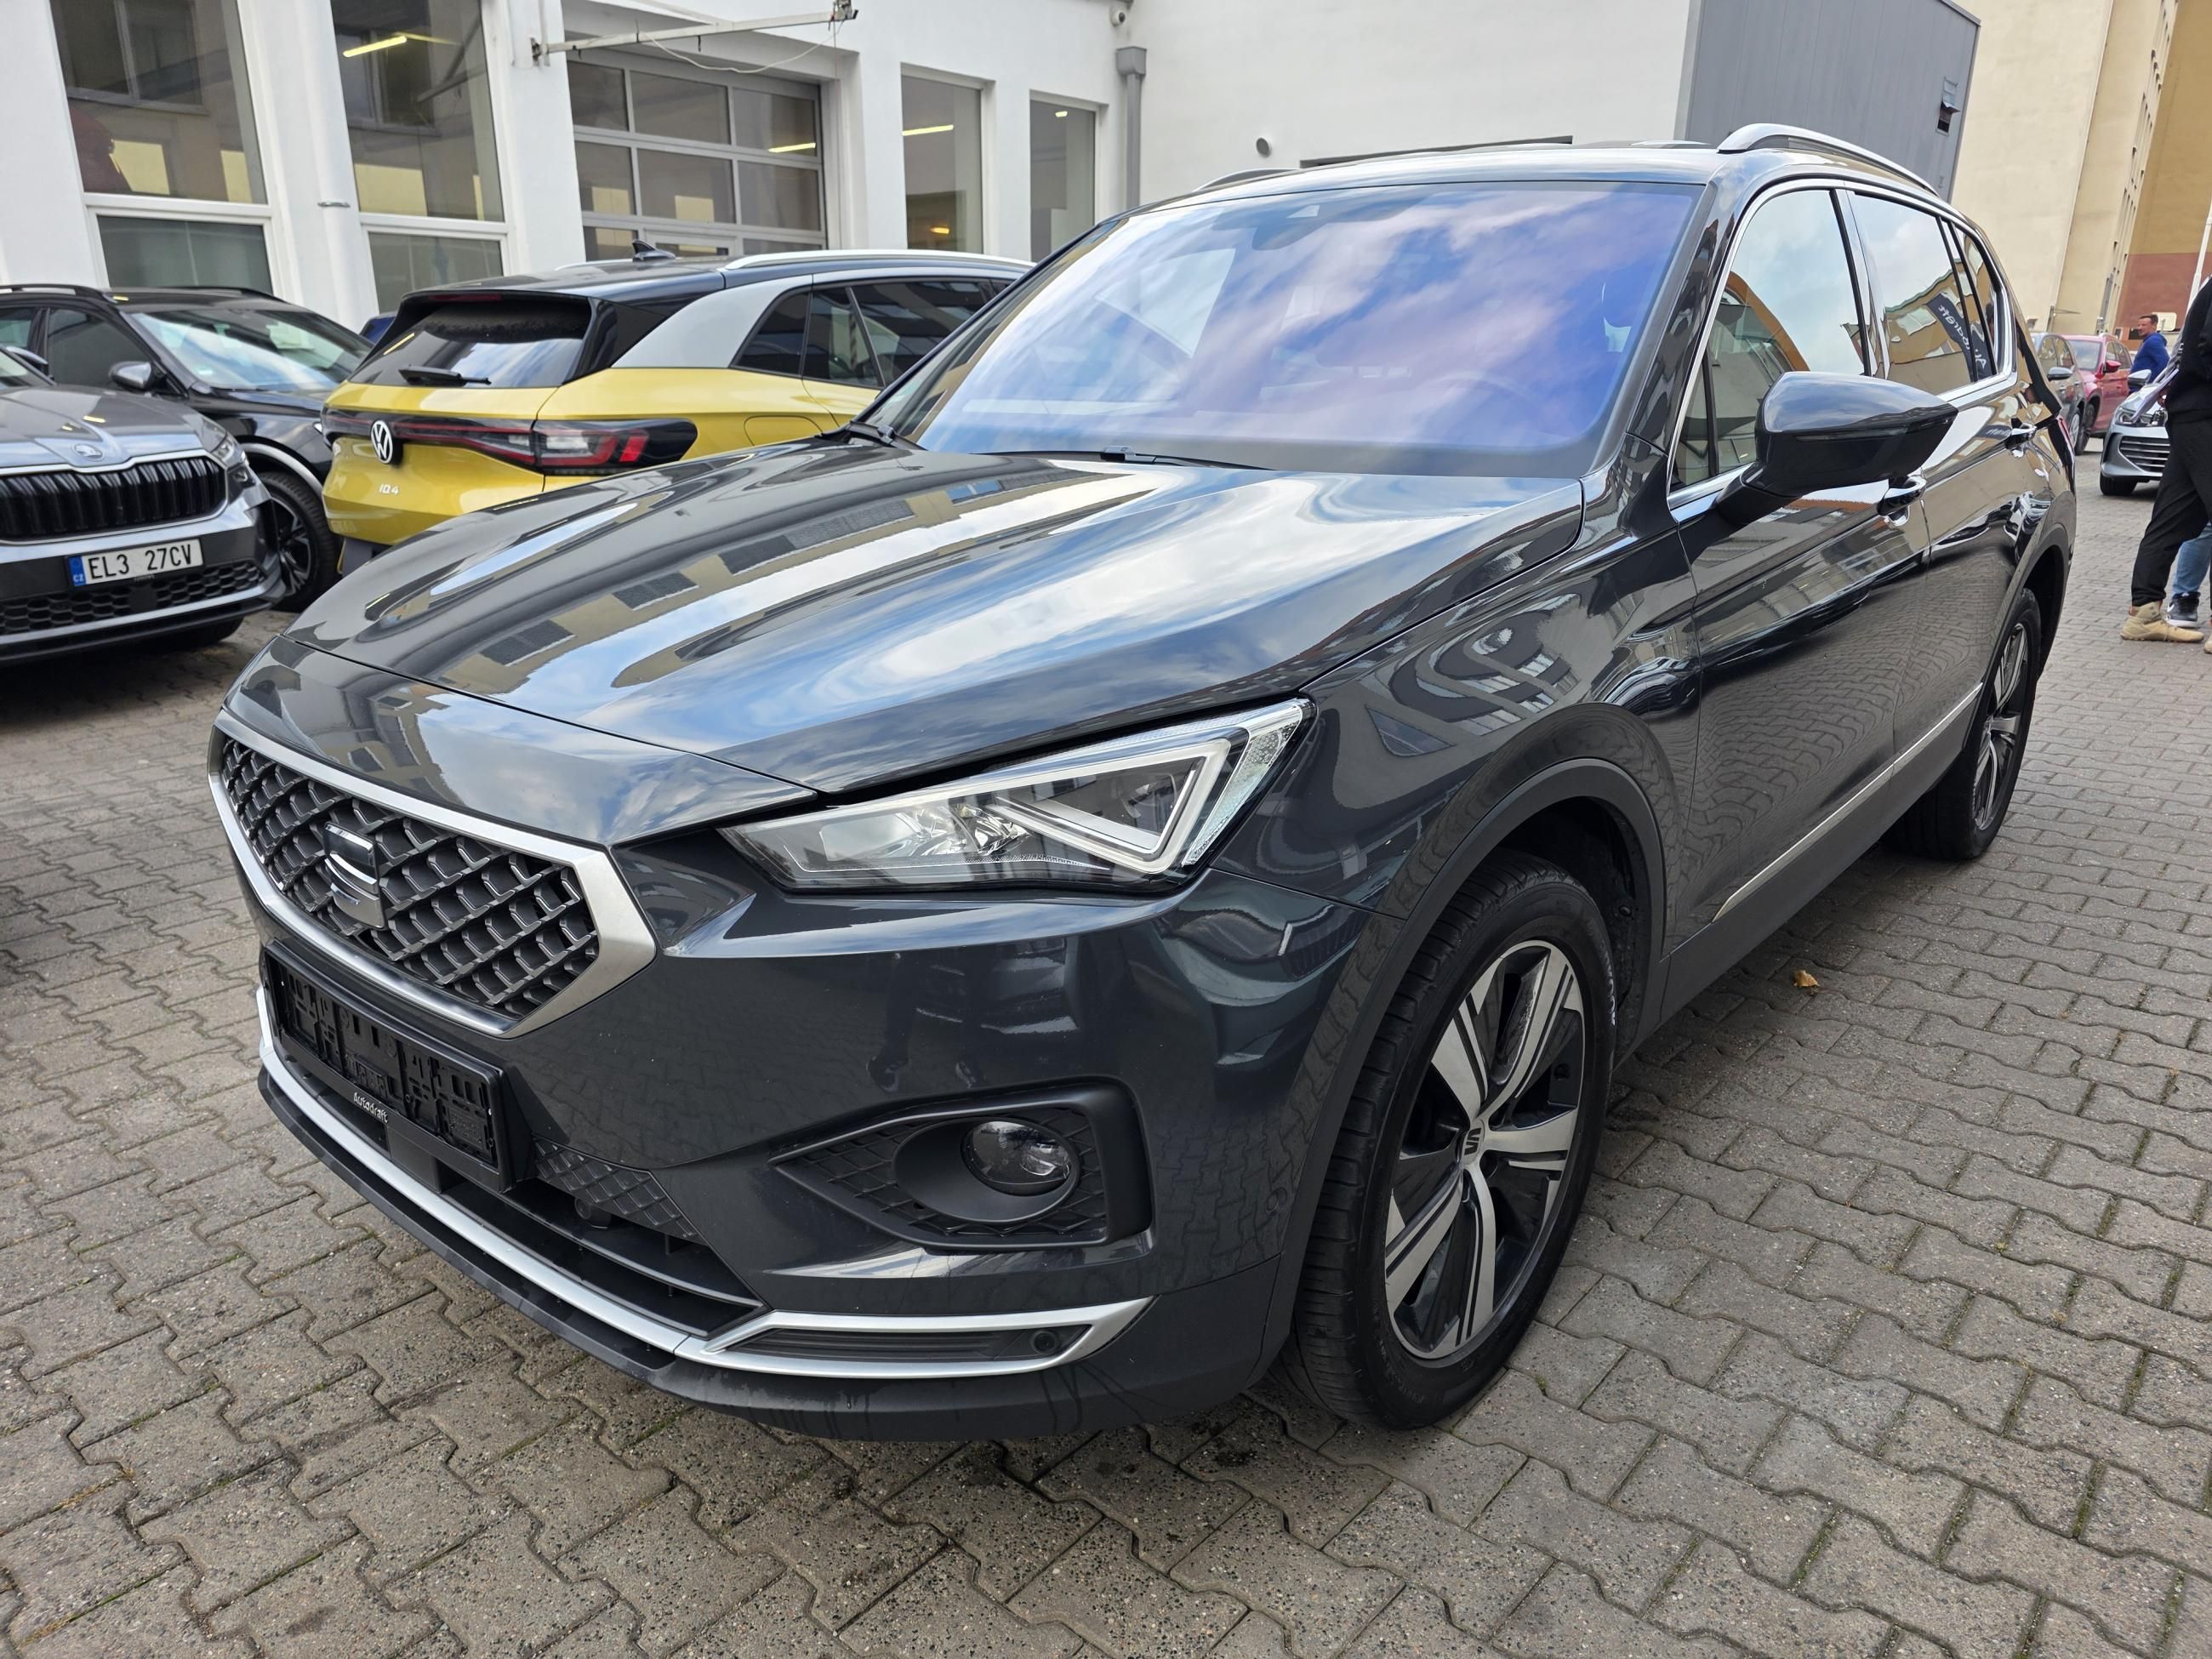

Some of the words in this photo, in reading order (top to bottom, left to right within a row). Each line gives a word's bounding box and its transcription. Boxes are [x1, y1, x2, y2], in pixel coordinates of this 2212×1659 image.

[88, 554, 129, 579] EL3
[145, 544, 191, 571] 27CV
[72, 573, 84, 582] CZ
[353, 1092, 388, 1123] Autodraft
